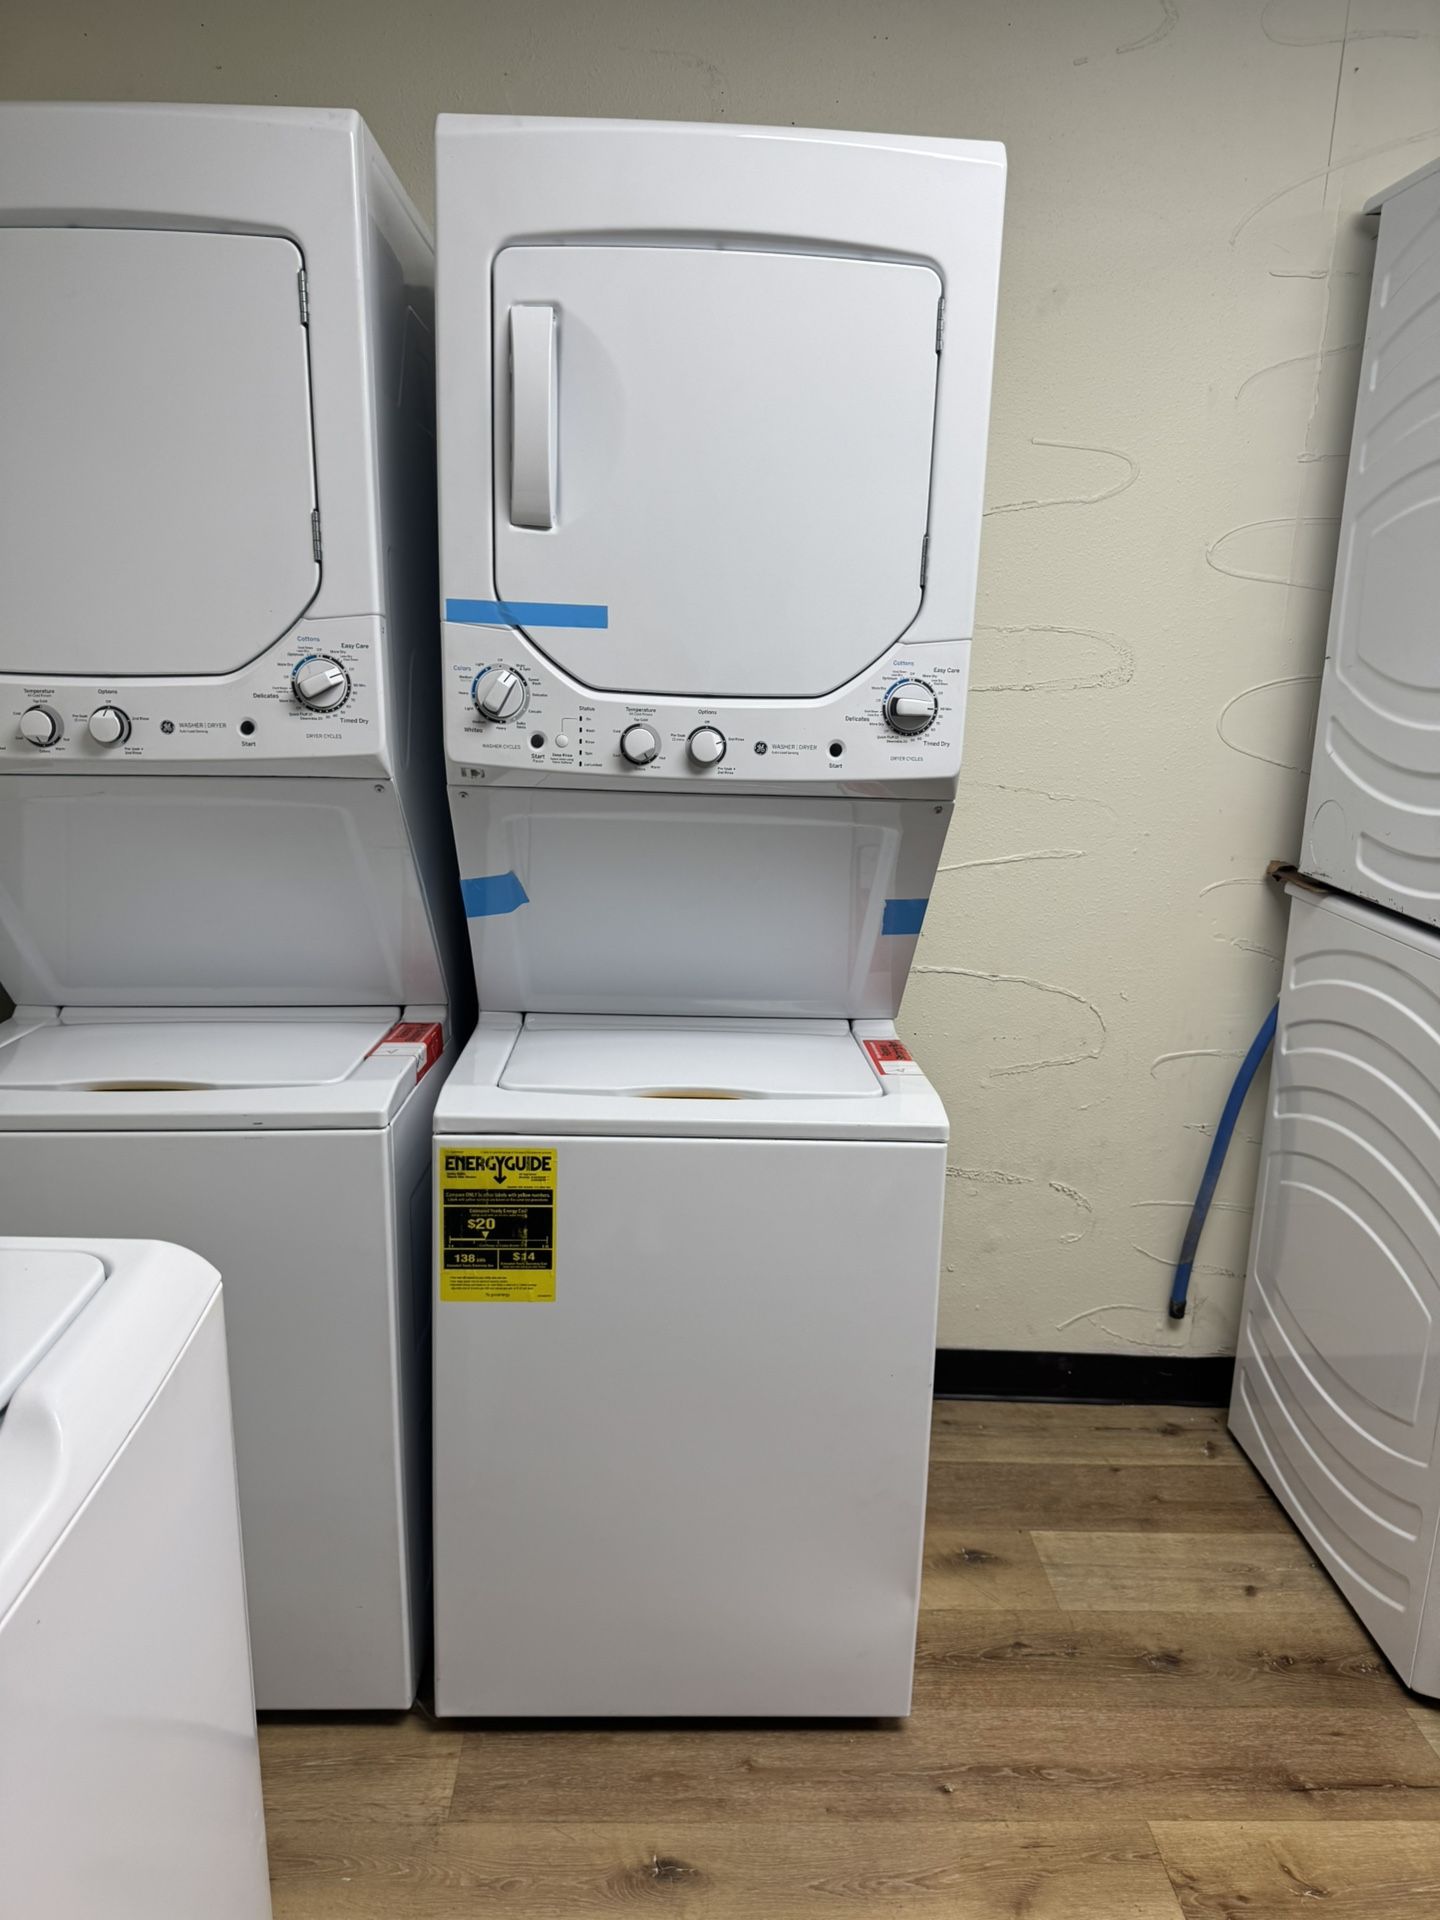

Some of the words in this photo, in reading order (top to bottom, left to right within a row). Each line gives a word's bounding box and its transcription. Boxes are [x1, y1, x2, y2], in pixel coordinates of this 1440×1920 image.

[626, 706, 657, 714] Temperature
[698, 709, 717, 717] Options
[940, 741, 951, 749] Dry
[445, 1155, 552, 1172] ENERGYGUIDE
[467, 1218, 496, 1231] $20
[454, 1254, 476, 1263] 138
[513, 1252, 536, 1261] $14
